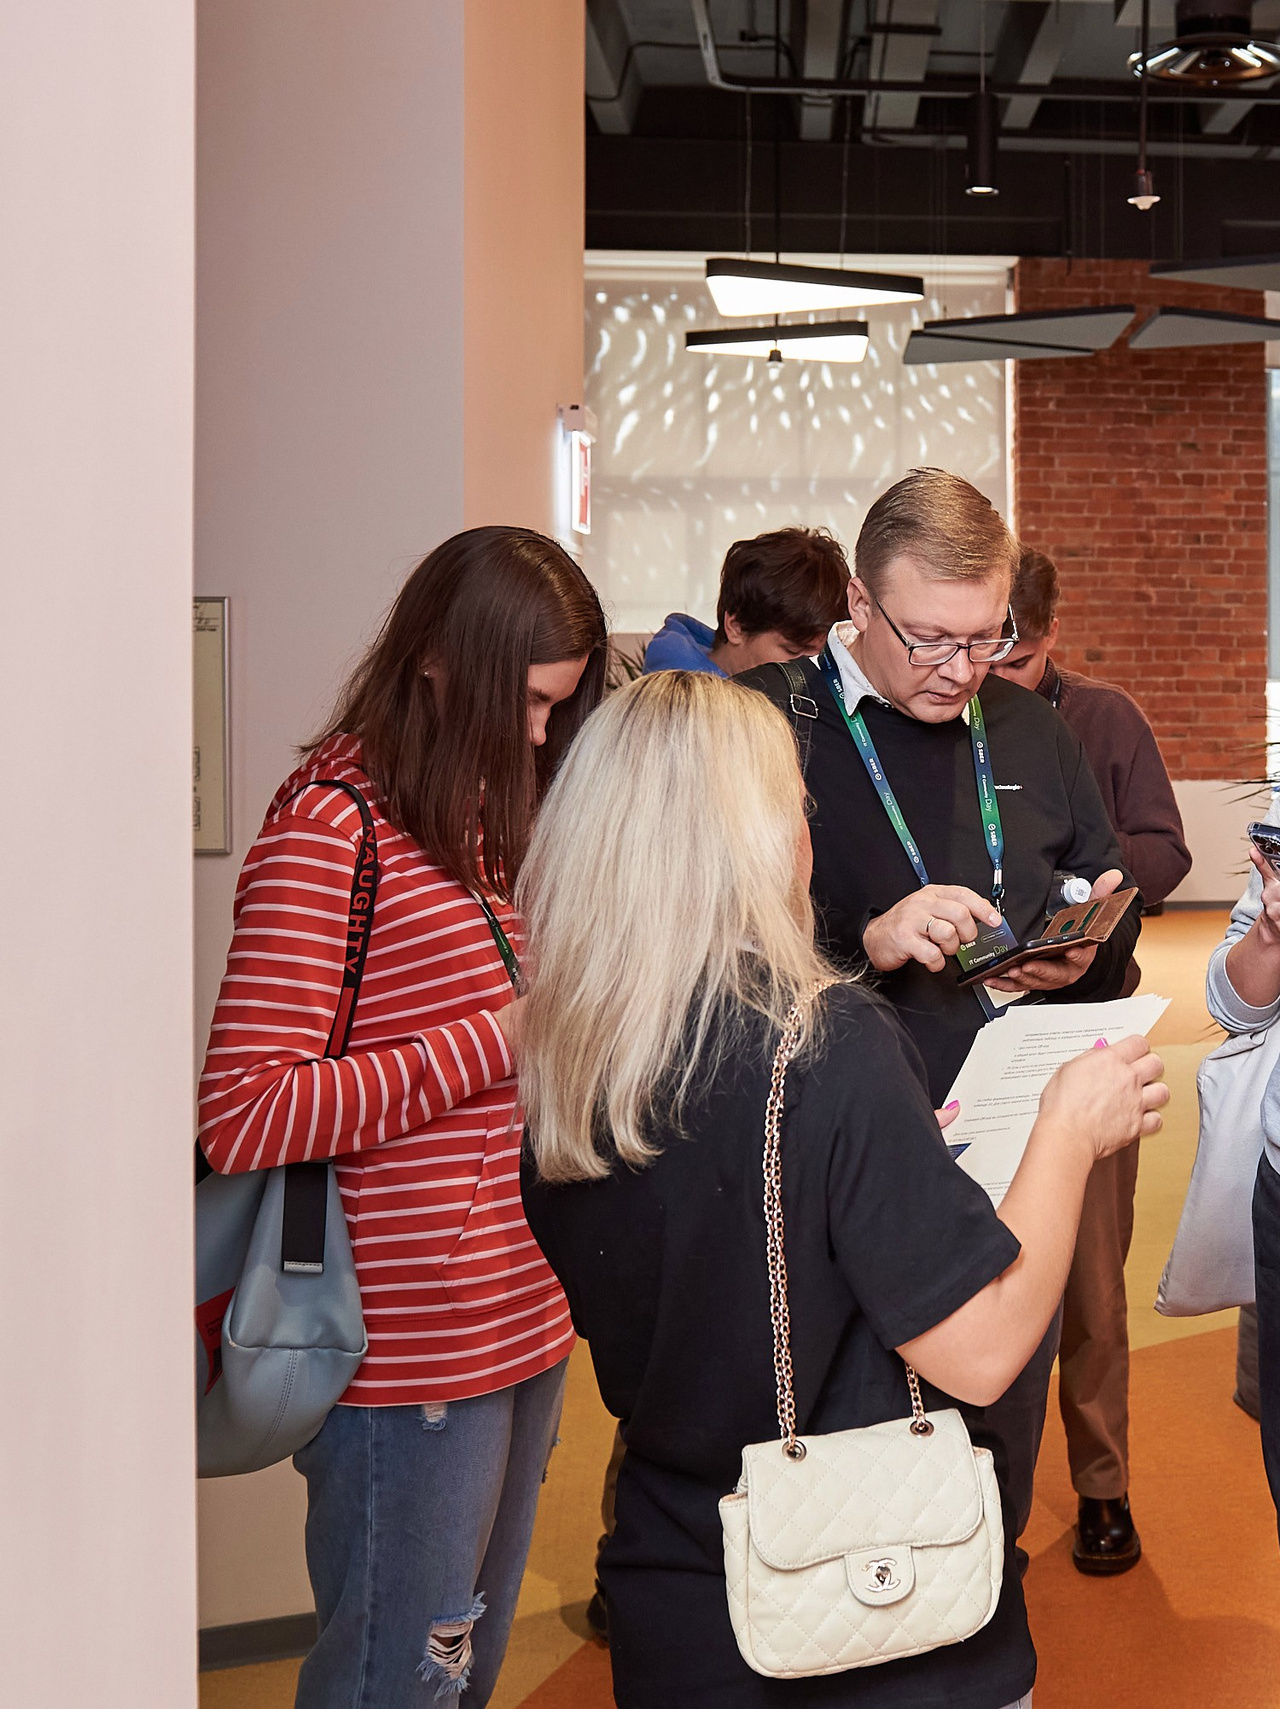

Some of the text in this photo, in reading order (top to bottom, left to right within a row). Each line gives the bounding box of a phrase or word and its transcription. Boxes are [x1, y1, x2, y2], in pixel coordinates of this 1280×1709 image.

[989, 829, 998, 847] SBER
[345, 825, 376, 974] NAUGHTY
[965, 941, 977, 950] SBER
[973, 951, 996, 964] Community
[993, 943, 1009, 956] Day
